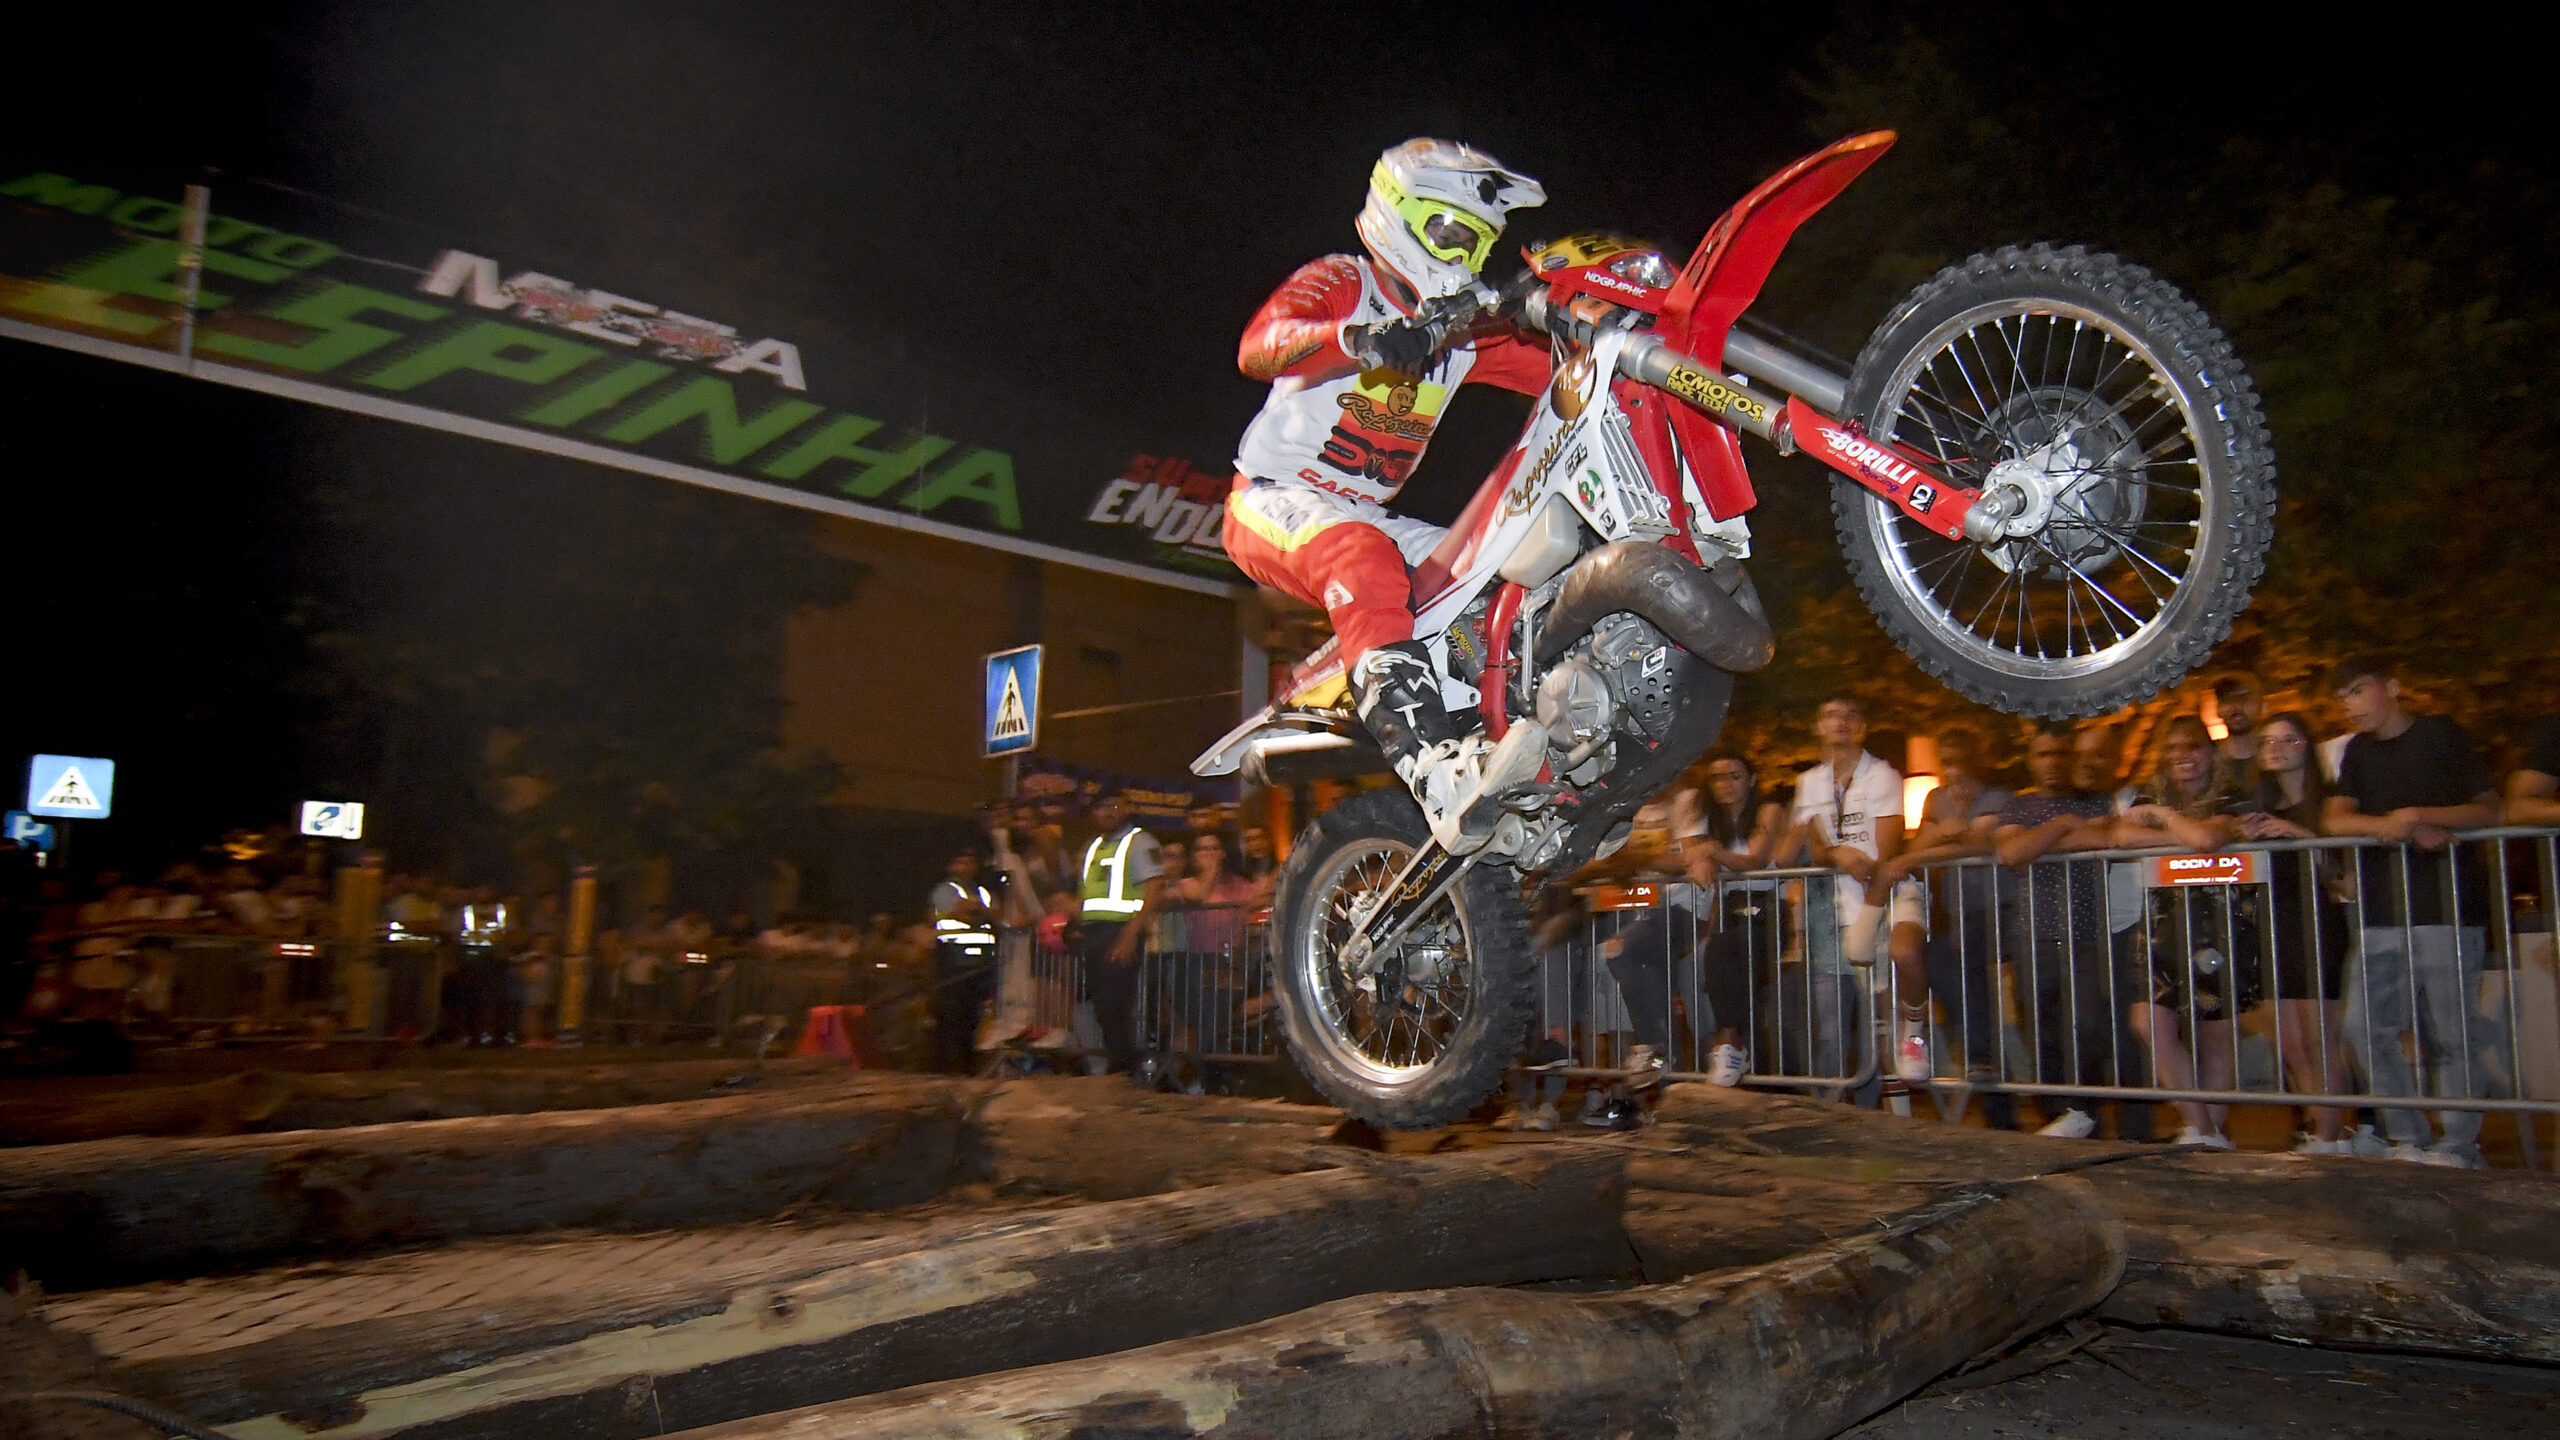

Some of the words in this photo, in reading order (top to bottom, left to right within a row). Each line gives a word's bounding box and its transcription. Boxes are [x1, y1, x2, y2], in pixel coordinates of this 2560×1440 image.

[0, 171, 343, 268] MOTO
[1584, 271, 1647, 298] NDGRAPHIC
[5, 236, 1023, 530] ESPINHA
[1666, 375, 1697, 399] RACE
[1697, 391, 1728, 414] TECH
[1669, 363, 1766, 419] LCMOTOS
[1816, 427, 1919, 485] BORILLI
[1859, 464, 1901, 494] Racing
[1086, 478, 1227, 548] ENDU
[1909, 484, 1933, 512] ND
